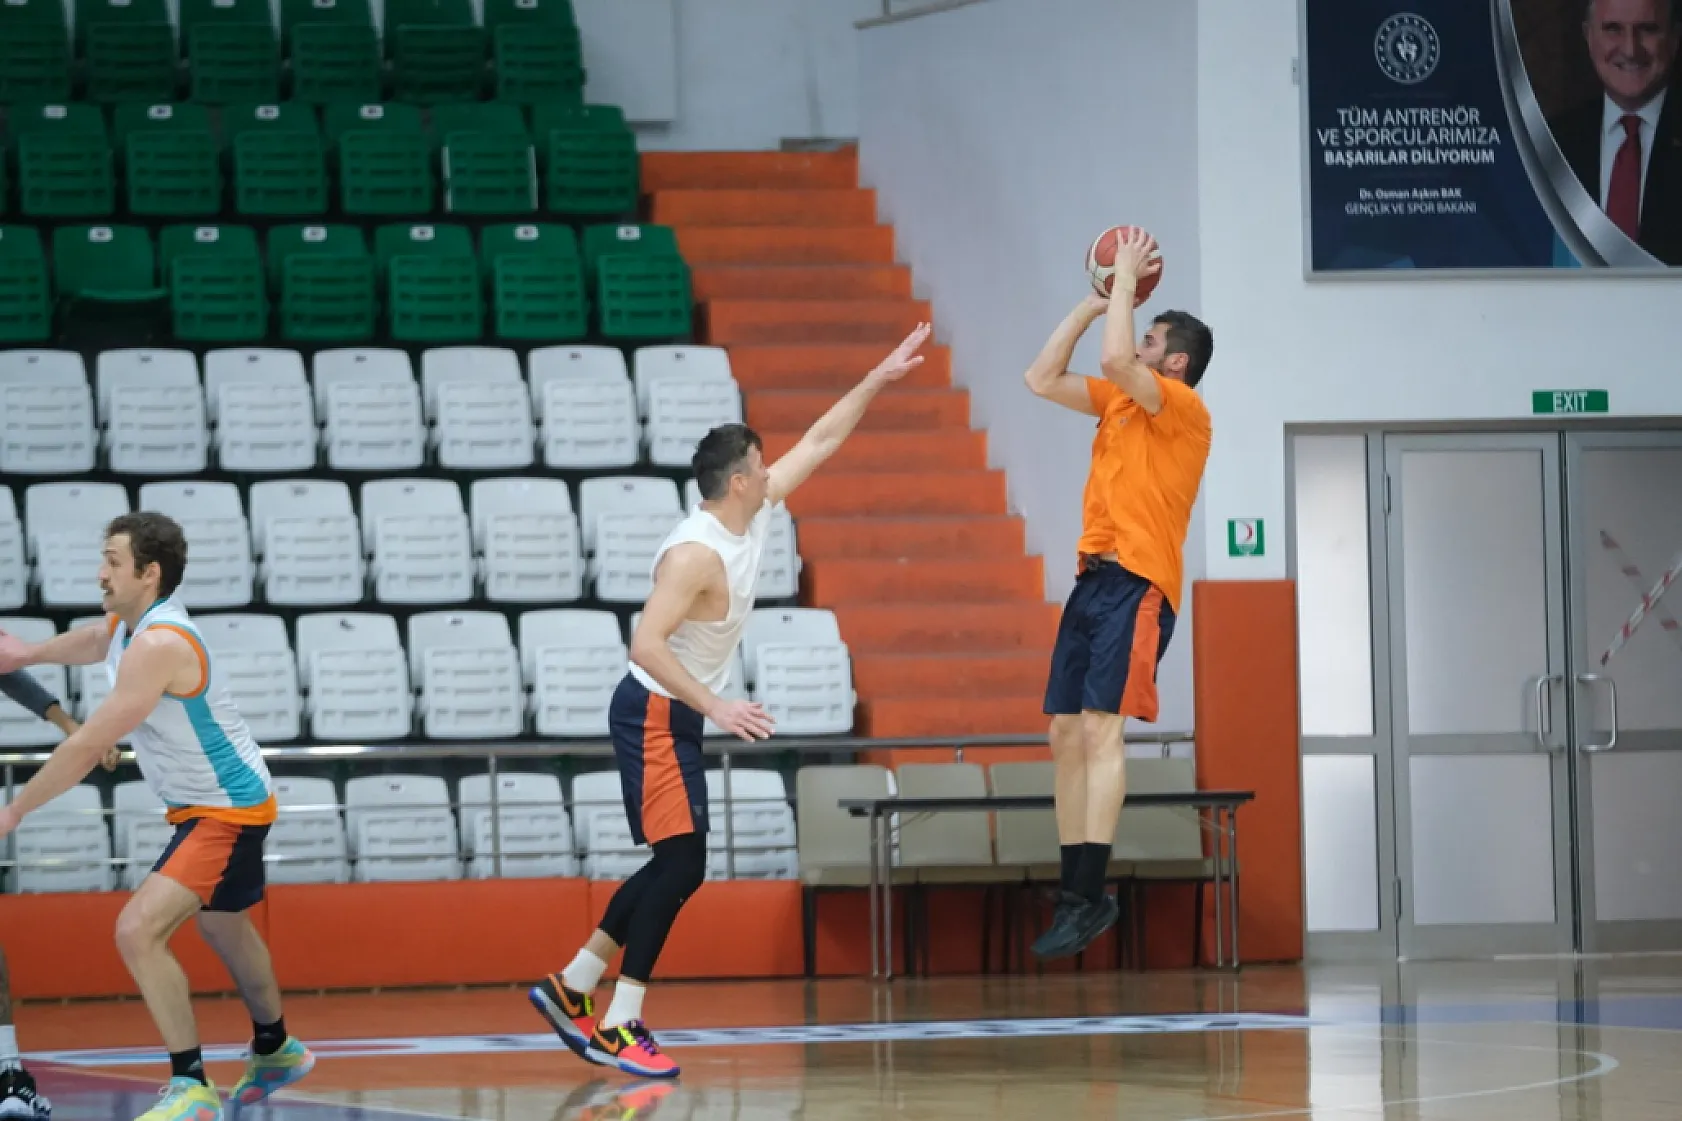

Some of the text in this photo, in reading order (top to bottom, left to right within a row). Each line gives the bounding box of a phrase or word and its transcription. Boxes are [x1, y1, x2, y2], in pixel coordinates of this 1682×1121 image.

[1336, 105, 1480, 127] TÜM ANTRENÖR
[1317, 127, 1501, 146] VE SPORCULARIMIZA
[1324, 146, 1495, 168] BAŞARILAR DİLİYORUM
[1553, 391, 1588, 413] EXIT
